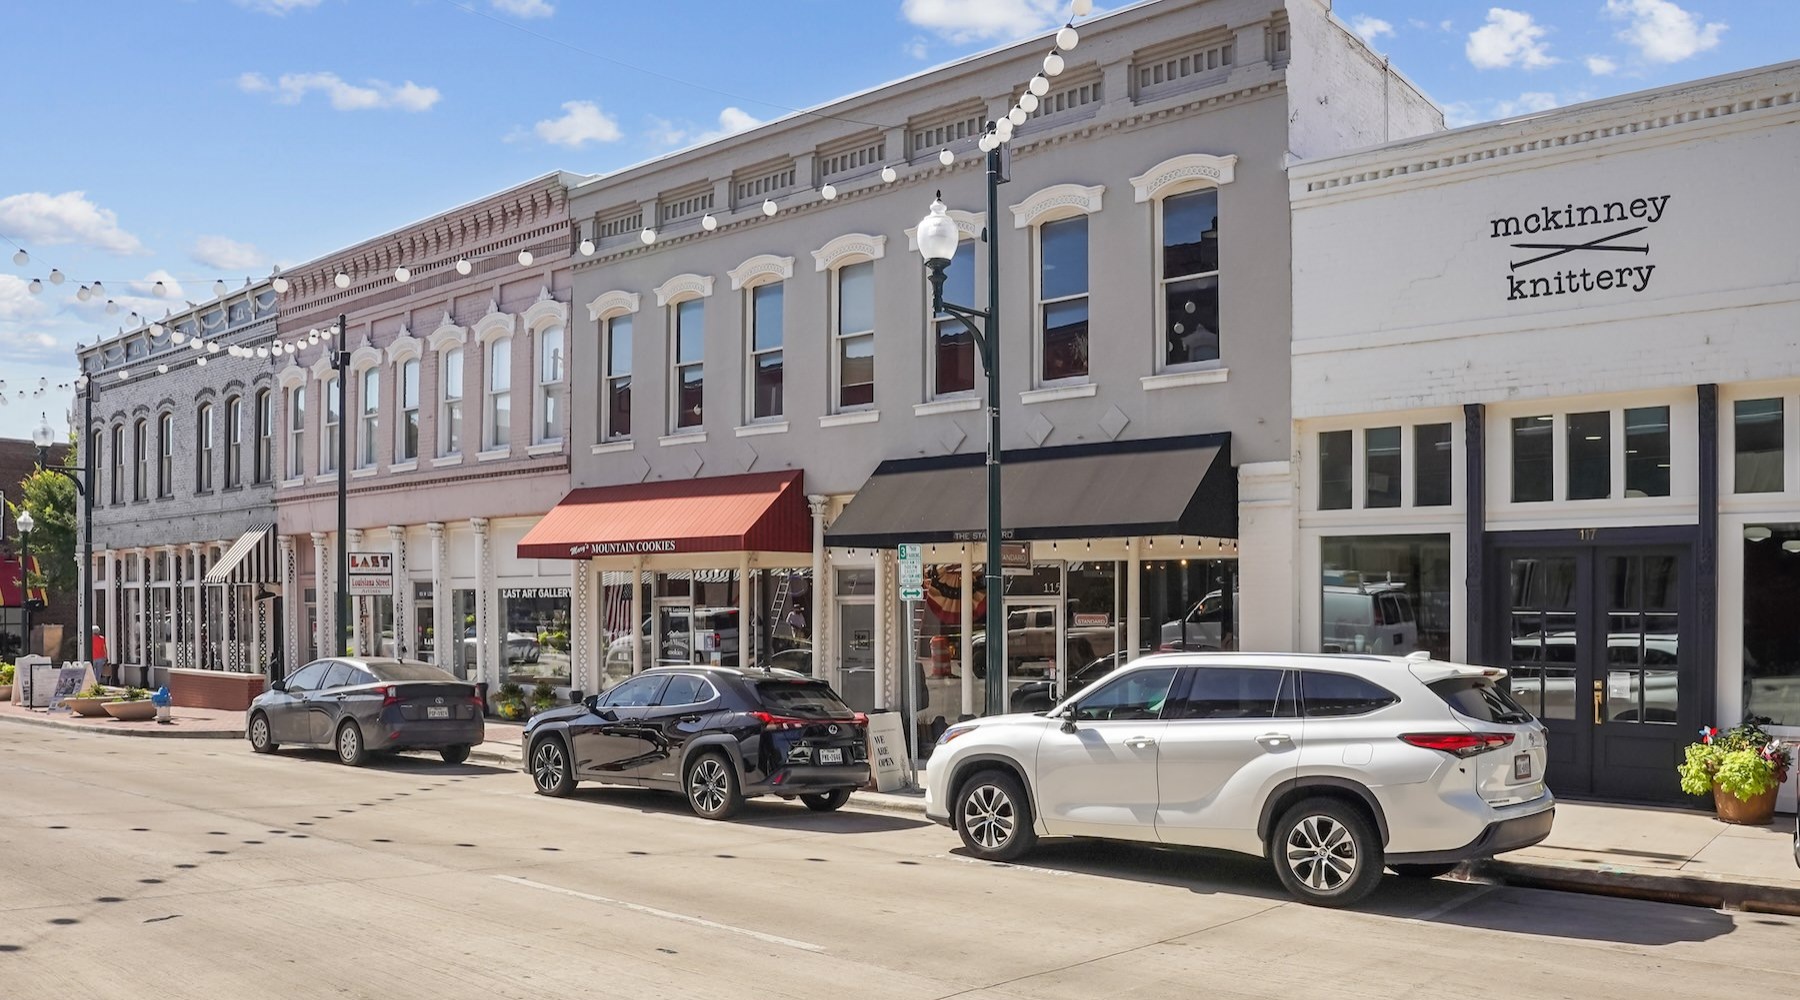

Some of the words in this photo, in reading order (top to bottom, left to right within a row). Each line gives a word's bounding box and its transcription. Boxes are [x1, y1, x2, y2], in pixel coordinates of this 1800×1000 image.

[1490, 194, 1671, 238] mckinney
[1507, 264, 1656, 300] knittery
[954, 532, 970, 540] THE
[973, 530, 1014, 540] STARD
[591, 543, 634, 554] MOUNTAIN
[636, 540, 676, 552] COOKIES
[900, 546, 906, 558] 3
[351, 555, 390, 568] LAST
[376, 578, 390, 587] Street
[503, 589, 521, 598] LAST
[522, 589, 537, 598] ART
[538, 588, 572, 598] GALLERY
[874, 735, 885, 744] WE
[877, 746, 889, 755] ARE
[878, 757, 894, 767] OPEN
